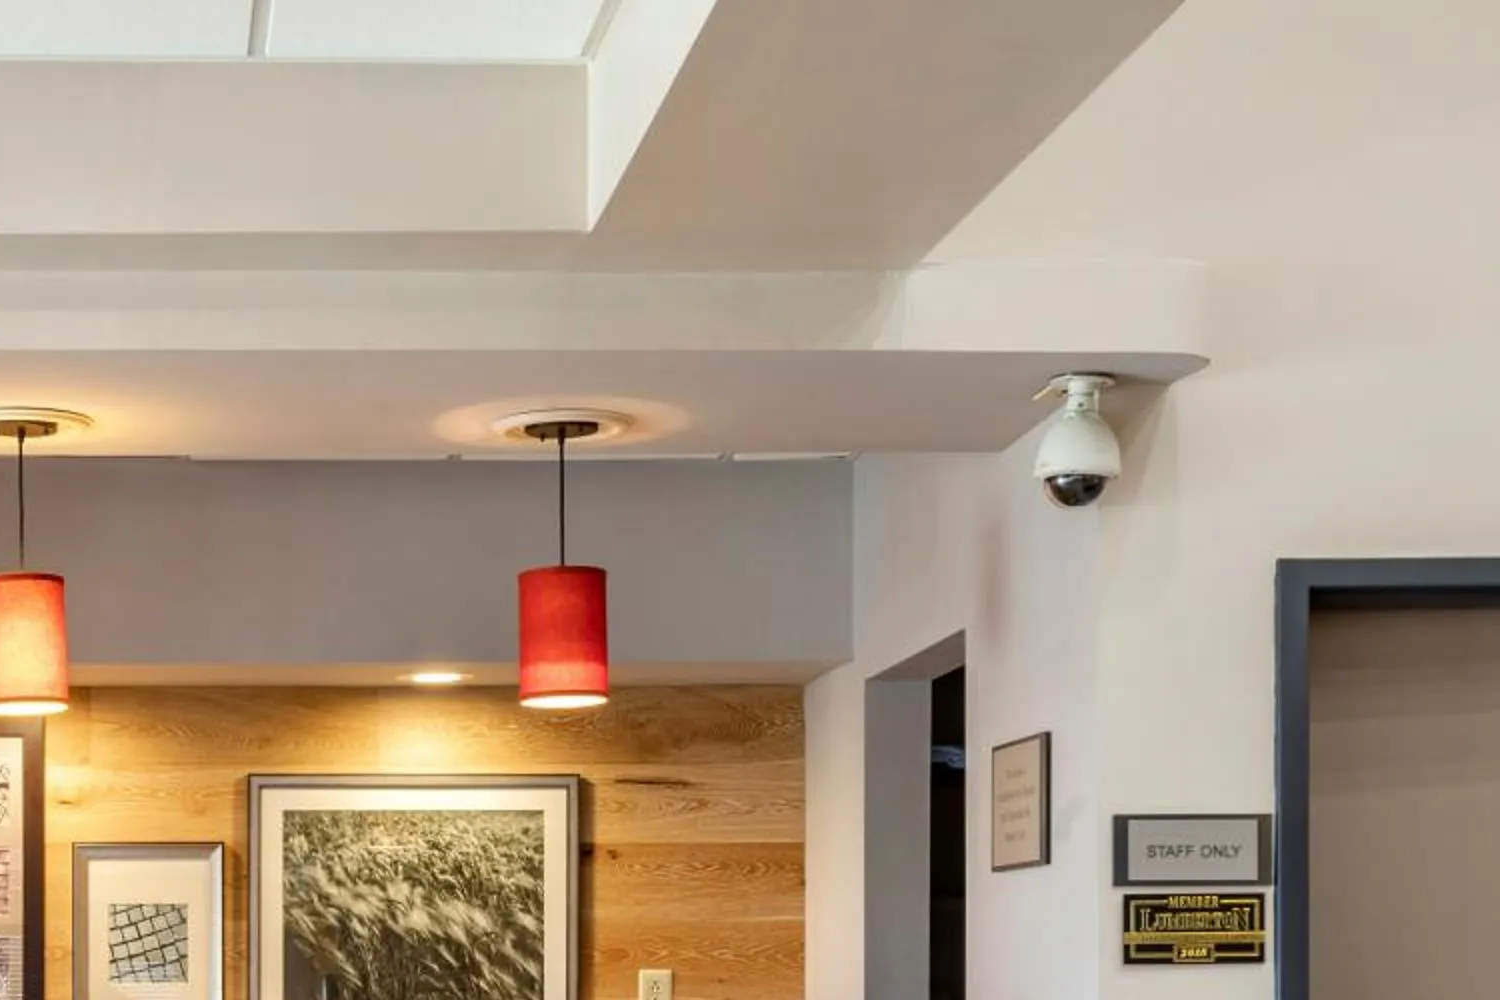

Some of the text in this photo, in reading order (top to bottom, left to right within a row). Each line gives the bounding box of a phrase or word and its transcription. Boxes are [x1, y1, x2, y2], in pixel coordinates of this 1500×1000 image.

[1146, 844, 1242, 859] STAFF ONLY
[1167, 895, 1219, 909] MEMBER
